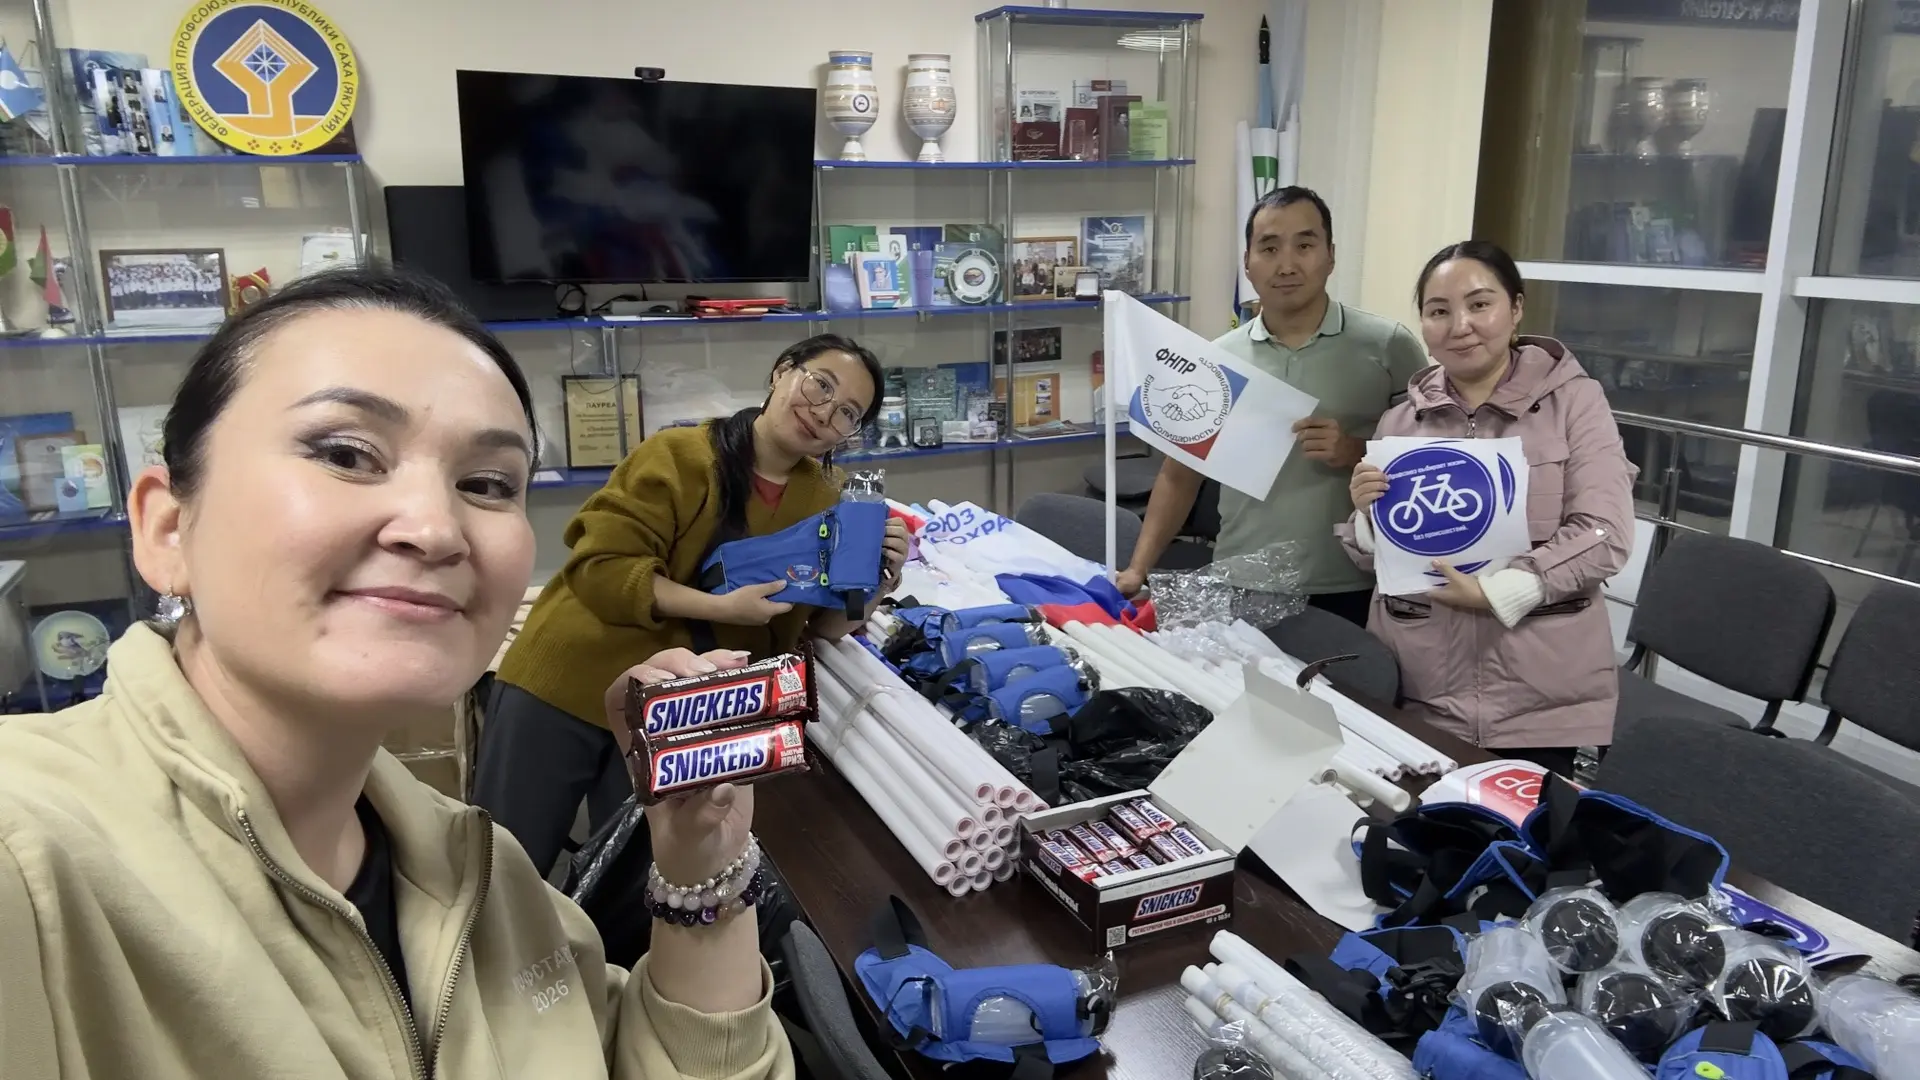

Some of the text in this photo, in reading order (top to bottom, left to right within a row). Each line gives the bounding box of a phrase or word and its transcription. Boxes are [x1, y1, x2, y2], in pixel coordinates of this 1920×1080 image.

[175, 0, 238, 59] ПРОФСОЮЗ
[335, 42, 353, 77] САХА
[176, 62, 228, 136] ФЕДЕРАЦИЯ
[321, 81, 354, 134] (ЯКУТИЯ)
[1155, 348, 1197, 375] ФНПР
[1152, 420, 1215, 443] Солидарность
[648, 684, 763, 734] SNICKERS
[658, 737, 765, 787] SNICKERS
[1138, 886, 1200, 916] SNICKERS
[532, 979, 569, 1014] 2026
